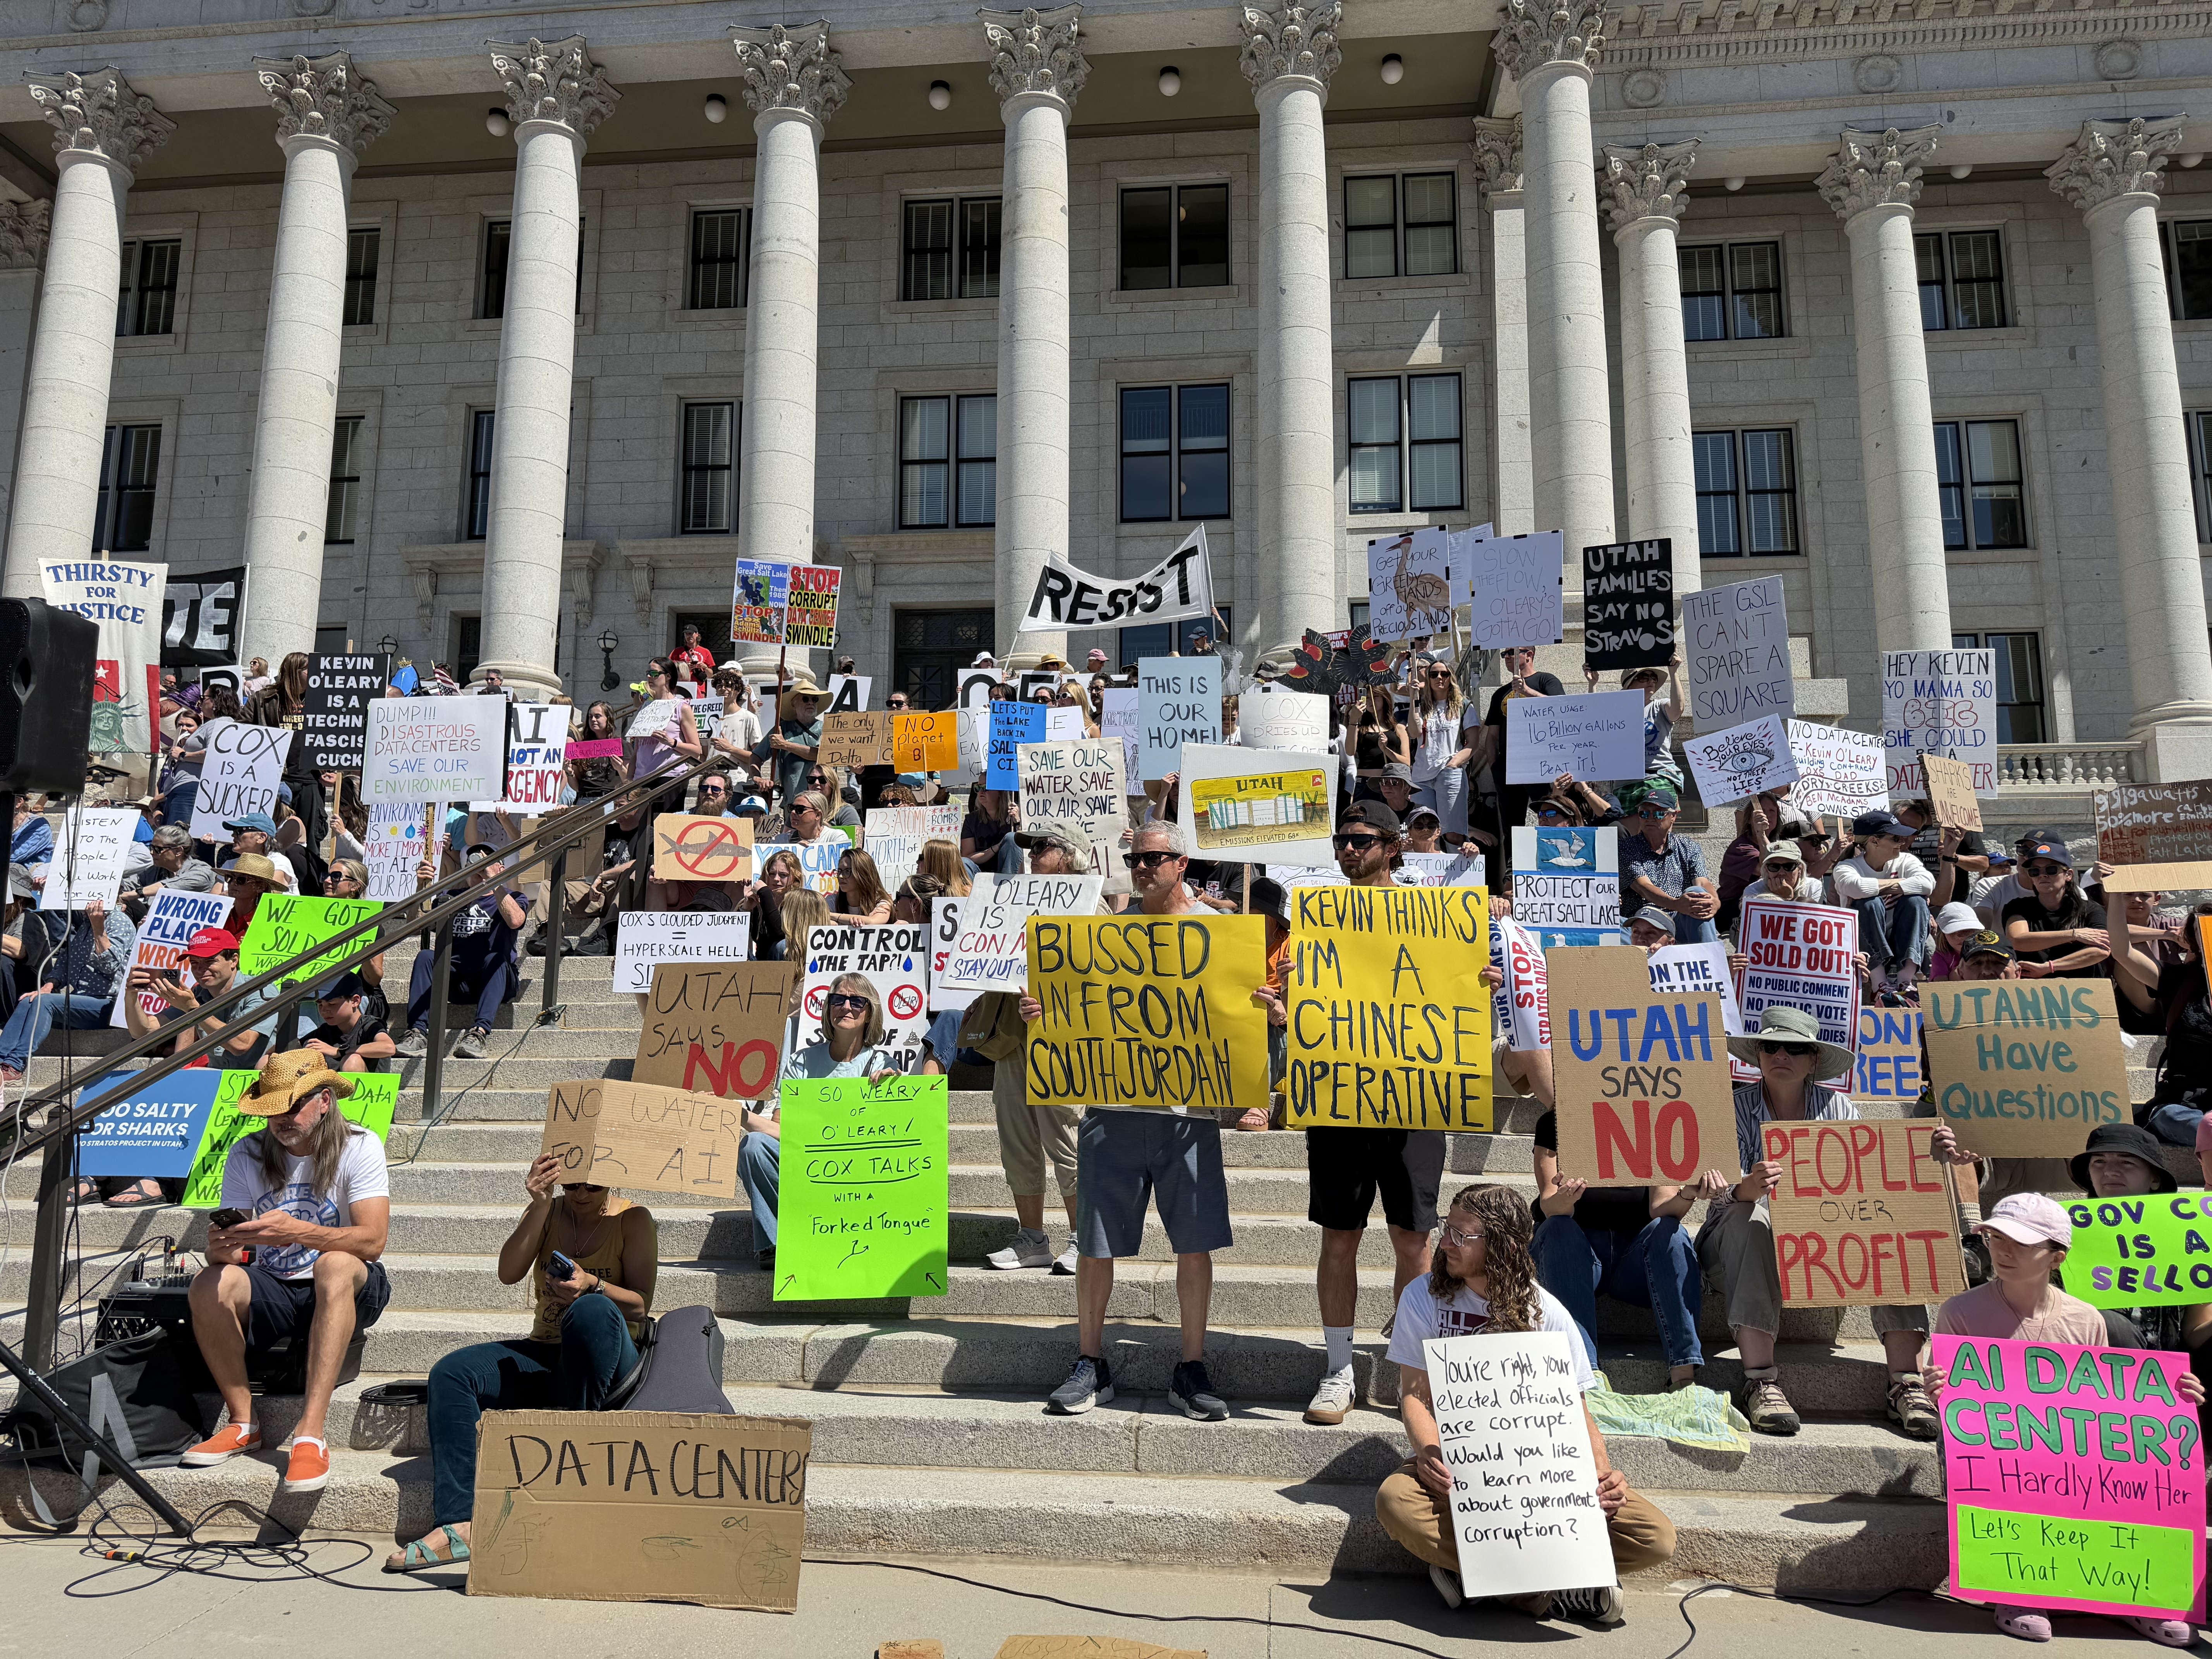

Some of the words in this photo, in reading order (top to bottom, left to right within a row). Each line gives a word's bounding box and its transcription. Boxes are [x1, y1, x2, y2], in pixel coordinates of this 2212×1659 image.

[754, 562, 772, 570] Save
[1484, 545, 1537, 572] SLOW
[1588, 541, 1659, 572] UTAH
[46, 563, 155, 588] THIRSTY
[790, 566, 839, 594] STOP
[1028, 545, 1198, 624] RESIST
[1372, 570, 1422, 596] GREEDY
[1586, 570, 1672, 596] FAMILIES
[86, 587, 116, 598] FOR
[789, 591, 836, 609] CORRUPT
[734, 604, 773, 618] STOP
[787, 607, 807, 625] DATA
[1588, 603, 1630, 623] SAY
[1637, 603, 1665, 619] NO
[1685, 592, 1724, 620] THE
[733, 632, 782, 644] SWINDLE
[785, 624, 833, 647] SWINDLE
[1697, 612, 1772, 649] CAN'T
[320, 657, 374, 670] KEVIN
[1694, 647, 1760, 684] SPARE
[1767, 644, 1783, 671] A
[1887, 654, 1918, 677] HEY
[1929, 653, 1989, 675] KEVIN
[309, 672, 382, 689] O'LEARY
[1142, 676, 1183, 694] THIS
[1190, 676, 1208, 693] IS
[1884, 680, 1905, 698] YO
[1914, 680, 1964, 698] MAMA
[1972, 680, 1992, 698] SO
[327, 695, 344, 708] IS
[348, 696, 360, 708] A
[703, 702, 723, 712] GREED
[992, 703, 1017, 715] LET'S
[1020, 706, 1035, 716] PUT
[1262, 698, 1310, 720] COX
[1695, 680, 1788, 719] SQUARE
[376, 706, 436, 724] DUMP!!!
[828, 716, 848, 728] The
[854, 714, 875, 731] only
[1007, 717, 1029, 726] LAKE
[1159, 704, 1208, 722] OUR
[1522, 706, 1555, 718] WATER
[1903, 698, 1978, 728] BIG
[381, 724, 476, 740] DISASTROUS
[905, 717, 934, 732] NO
[997, 728, 1013, 737] BACK
[1254, 726, 1302, 738] DRIES
[1791, 721, 1812, 738] NO
[1818, 728, 1853, 740] DATA
[214, 724, 288, 765] COX
[848, 734, 876, 744] want
[1885, 728, 1915, 747] SHE
[1925, 729, 1986, 747] COULD
[317, 754, 362, 767] CUCK
[543, 748, 561, 763] AN
[826, 751, 862, 764] Delta
[913, 749, 921, 761] B
[1029, 750, 1065, 771] SAVE
[1073, 749, 1113, 771] OUR
[221, 761, 234, 776] IS
[241, 766, 256, 782] A
[389, 759, 425, 774] SAVE
[434, 759, 469, 772] OUR
[1835, 769, 1857, 780] DAD
[375, 778, 485, 793] ENVIRONMENT
[1025, 775, 1077, 797] WATER,
[1080, 772, 1115, 792] SAVE
[1236, 776, 1283, 793] UTAH
[1733, 777, 1762, 792] LIES
[1947, 787, 1957, 798] ARE
[1026, 798, 1054, 818] OUR
[1084, 795, 1117, 817] SAVE
[931, 813, 958, 824] BOMBS
[1220, 836, 1254, 846] EMISSIONS
[1257, 833, 1286, 843] ELEVATED
[389, 857, 408, 872] AI
[1435, 859, 1455, 871] OUR
[1460, 861, 1484, 872] LAND
[993, 879, 1082, 909] O'LEARY
[1514, 875, 1595, 898] PROTECT
[1596, 883, 1616, 894] OUR
[155, 895, 223, 924] WRONG
[267, 898, 297, 923] WE
[620, 913, 654, 927] COX'S
[660, 914, 702, 926] CLOUDED
[980, 906, 1003, 929] IS
[1514, 903, 1555, 924] GREAT
[1557, 904, 1586, 922] SALT
[1590, 905, 1620, 925] LAKE
[810, 929, 926, 952] CONTROL
[1760, 914, 1797, 942] WE
[1802, 918, 1846, 947] GOT
[624, 943, 701, 957] HYPERSCALE
[708, 945, 743, 957] HELL.
[960, 933, 1005, 955] CON
[1036, 921, 1211, 980] BUSSED
[817, 955, 848, 972] THE
[857, 954, 902, 972] TAP?!
[1750, 942, 1802, 969] SOLD
[1807, 947, 1850, 975] OUT!
[1391, 943, 1425, 998] A
[1513, 941, 1534, 1008] STOP
[1674, 960, 1712, 981] THE
[655, 972, 785, 1015] UTAH
[1748, 976, 1762, 988] NO
[1764, 977, 1800, 993] PUBLIC
[1802, 982, 1850, 998] COMMENT
[1747, 997, 1763, 1011] NO
[1816, 1004, 1847, 1021] VOTE
[1295, 999, 1482, 1067] CHINESE
[1569, 1002, 1712, 1062] UTAH
[1745, 1020, 1759, 1033] NO
[1977, 1034, 2078, 1073] Have
[682, 1039, 778, 1096] NO
[818, 1086, 842, 1102] SO
[860, 1085, 921, 1101] WEARY
[1290, 1059, 1484, 1128] OPERATIVE
[1601, 1066, 1681, 1099] SAYS
[133, 1104, 198, 1118] SALTY
[553, 1085, 602, 1123] NO
[631, 1091, 736, 1142] WATER
[850, 1107, 866, 1117] OF
[1942, 1082, 2121, 1124] Questions
[118, 1122, 187, 1136] SHARKS
[1592, 1099, 1700, 1182] NO
[806, 1159, 853, 1178] COX
[869, 1156, 932, 1176] TALKS
[833, 1192, 861, 1202] WITH
[1820, 1200, 1894, 1222] OVER
[2068, 1201, 2144, 1228] GOV
[2116, 1234, 2156, 1259] IS
[2185, 1229, 2210, 1254] A
[1778, 1230, 1949, 1300] PROFIT
[1948, 1342, 2005, 1391] AI
[2024, 1346, 2177, 1407] DATA
[1437, 1389, 1502, 1411] elected
[1441, 1420, 1476, 1435] are
[1489, 1414, 1571, 1437] corrupt.
[1944, 1398, 2198, 1470] CENTER?
[505, 1434, 660, 1496] DATA
[1447, 1443, 1503, 1465] Would
[1514, 1444, 1544, 1467] you
[1553, 1444, 1580, 1458] like
[1454, 1479, 1468, 1492] to
[1483, 1471, 1530, 1487] learn
[1999, 1457, 2093, 1510] Hardly
[2155, 1468, 2192, 1511] Her
[1458, 1494, 1514, 1512] about
[2109, 1526, 2140, 1549] It
